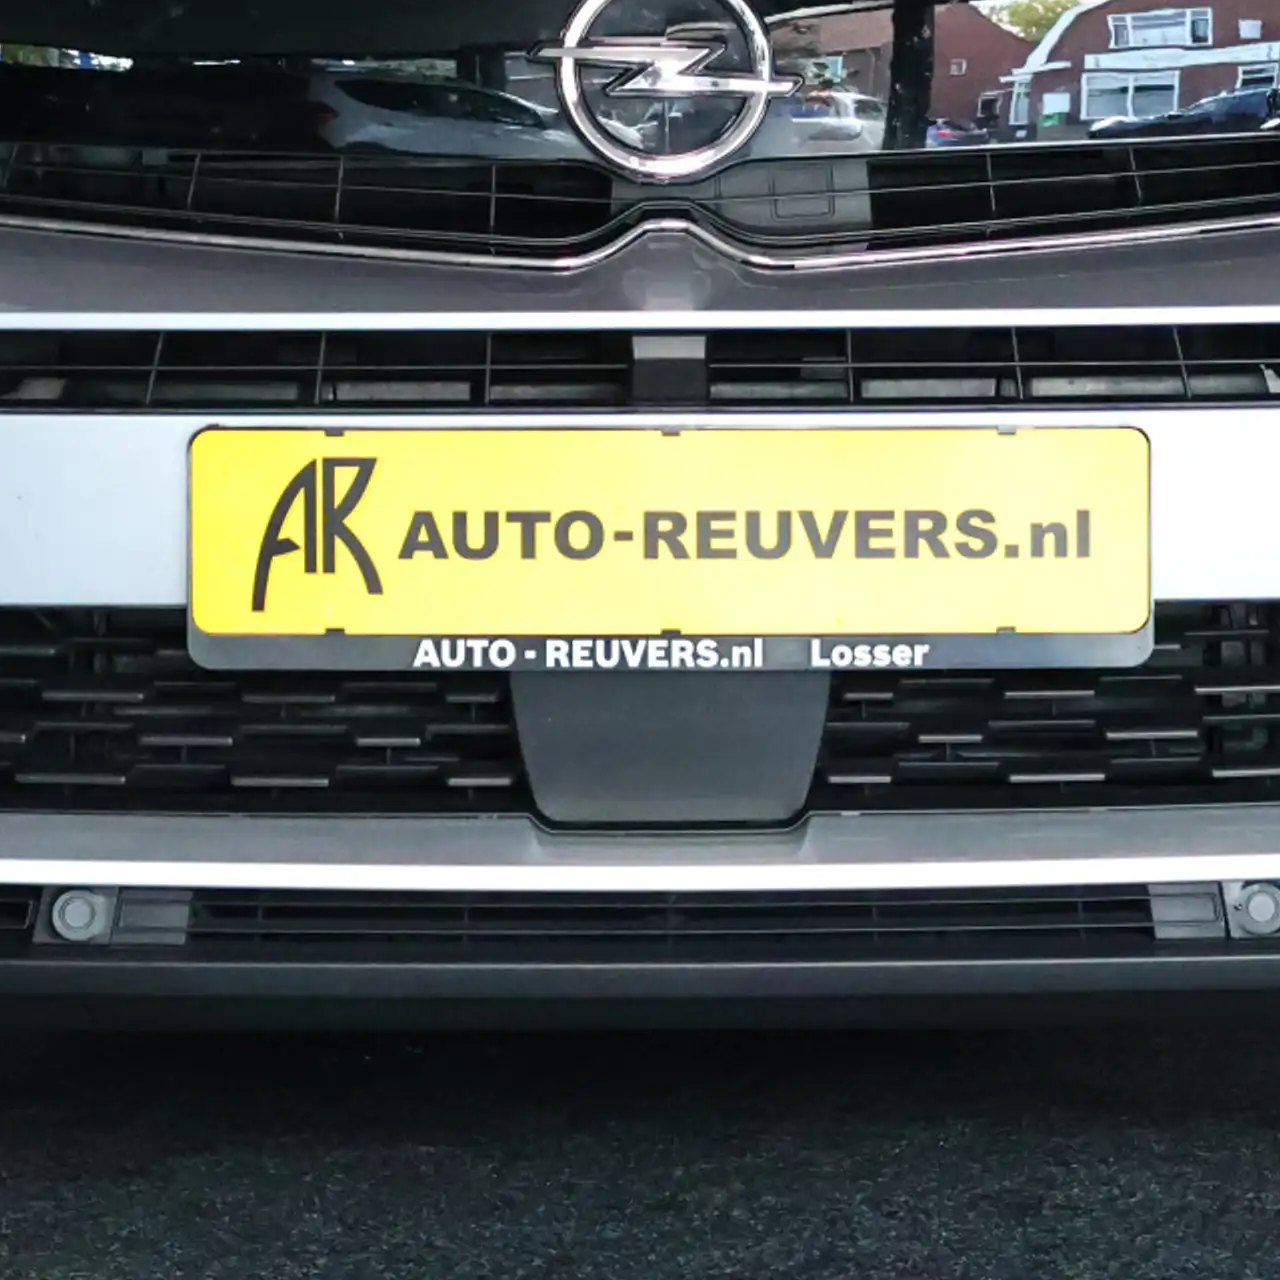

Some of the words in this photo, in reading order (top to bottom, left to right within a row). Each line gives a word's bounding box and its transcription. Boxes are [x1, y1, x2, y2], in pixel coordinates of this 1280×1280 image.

[398, 510, 1089, 560] AUTO-REUVERS.nl
[412, 638, 517, 669] AUTO
[545, 638, 764, 669] REUVERS.nl
[810, 638, 931, 669] Losser
